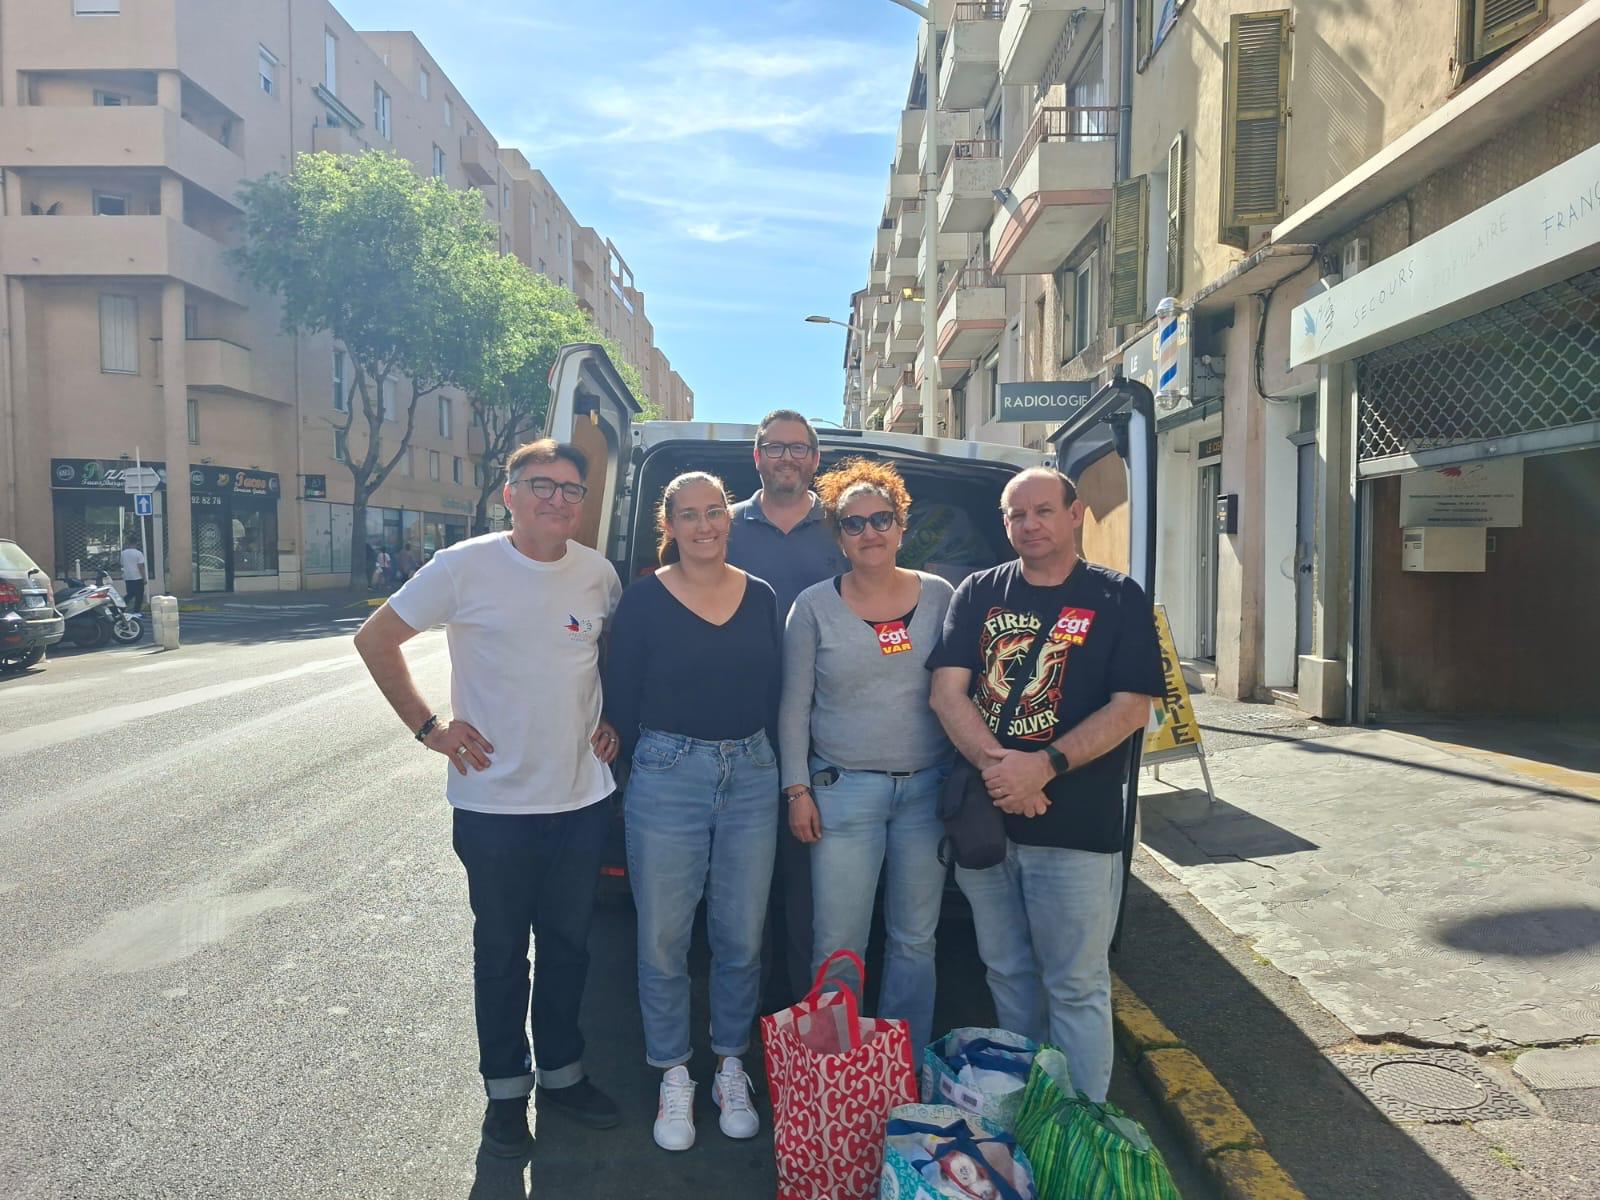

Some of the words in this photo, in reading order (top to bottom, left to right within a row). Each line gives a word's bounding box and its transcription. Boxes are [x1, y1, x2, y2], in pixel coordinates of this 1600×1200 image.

[1352, 259, 1415, 329] SECOURS
[1057, 616, 1091, 634] cgt
[878, 628, 908, 644] cgt
[1053, 632, 1084, 645] VAR
[882, 643, 912, 654] VAR
[991, 701, 1002, 714] IS
[1007, 709, 1060, 736] SOLVER
